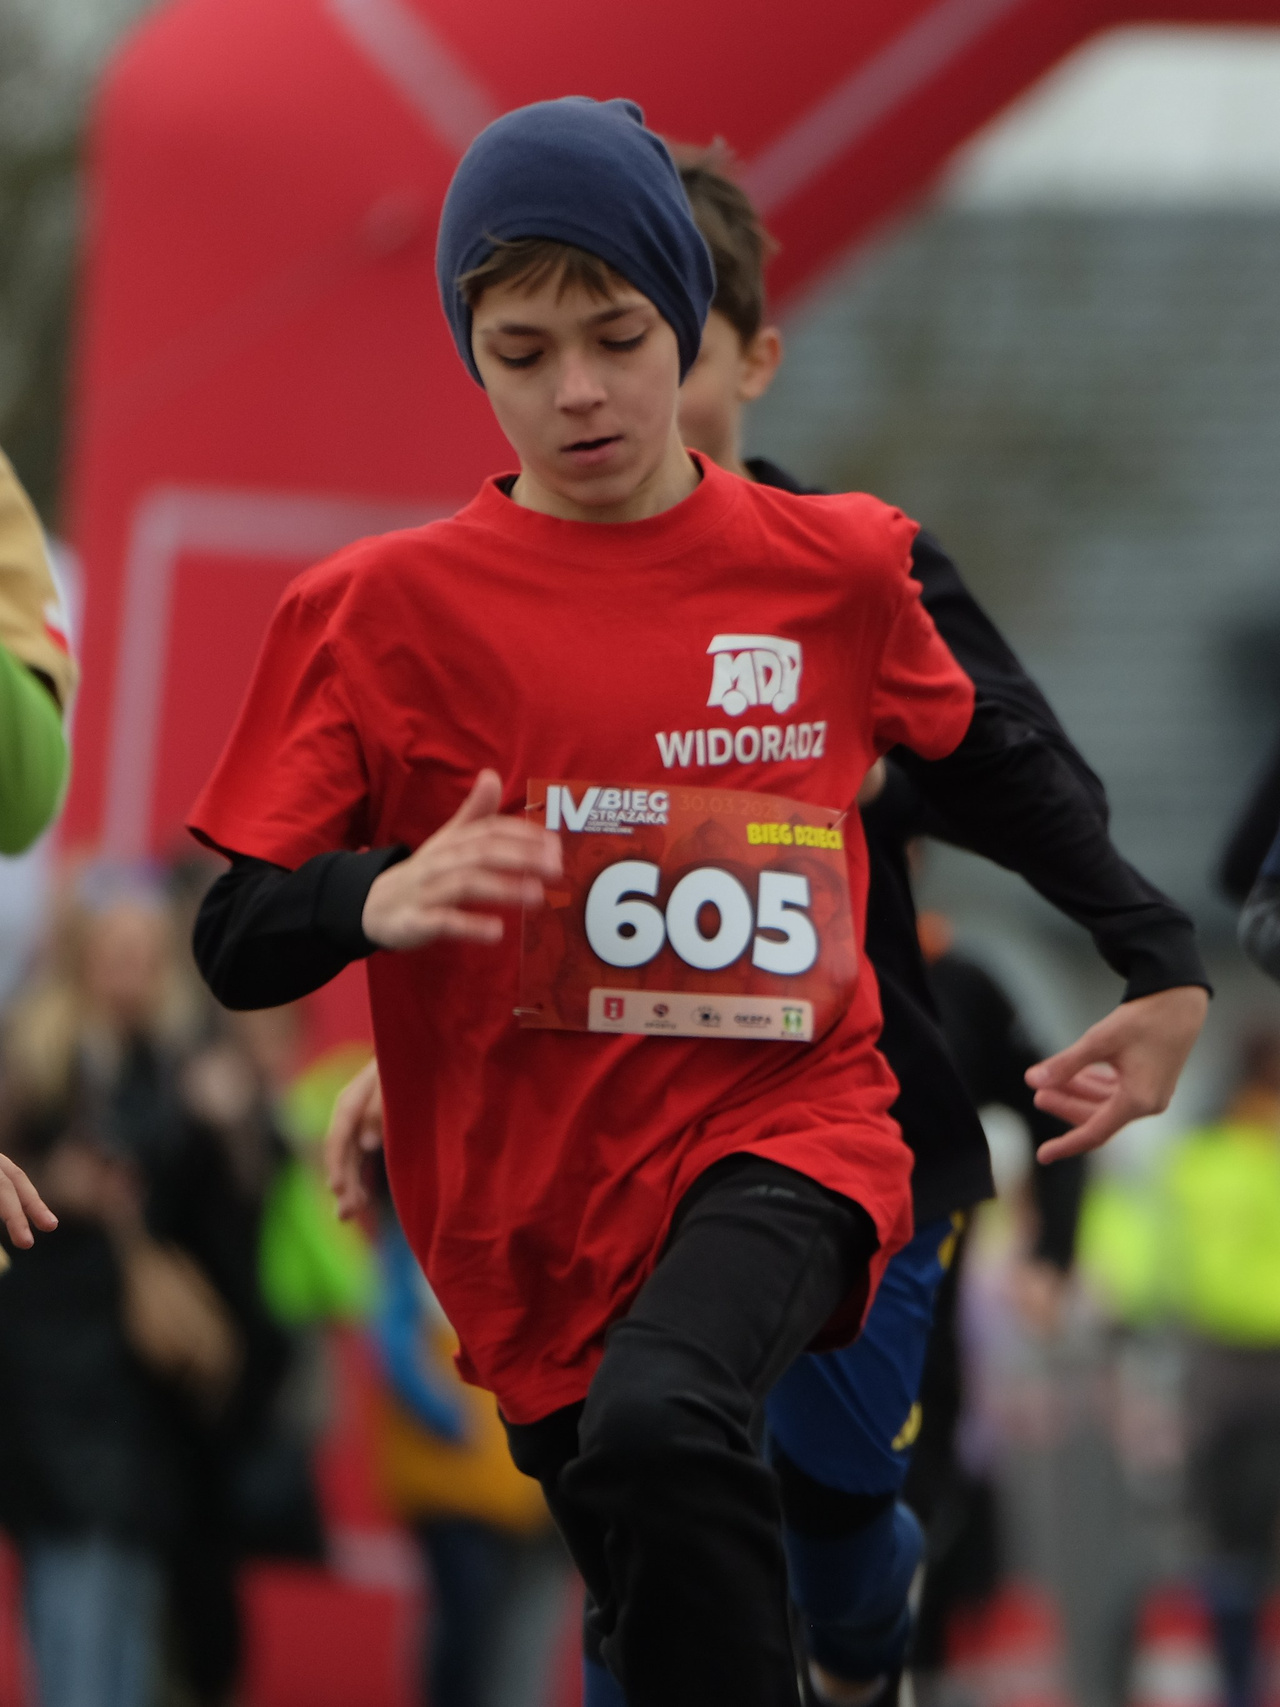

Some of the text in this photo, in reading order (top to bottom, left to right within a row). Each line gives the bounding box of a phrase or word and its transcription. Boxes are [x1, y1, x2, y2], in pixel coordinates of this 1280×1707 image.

[655, 720, 827, 768] WIDORADZ
[545, 784, 669, 832] IV BIEG
[589, 808, 669, 825] STRAŻAKA
[746, 822, 794, 845] BIEG
[585, 860, 819, 977] 605
